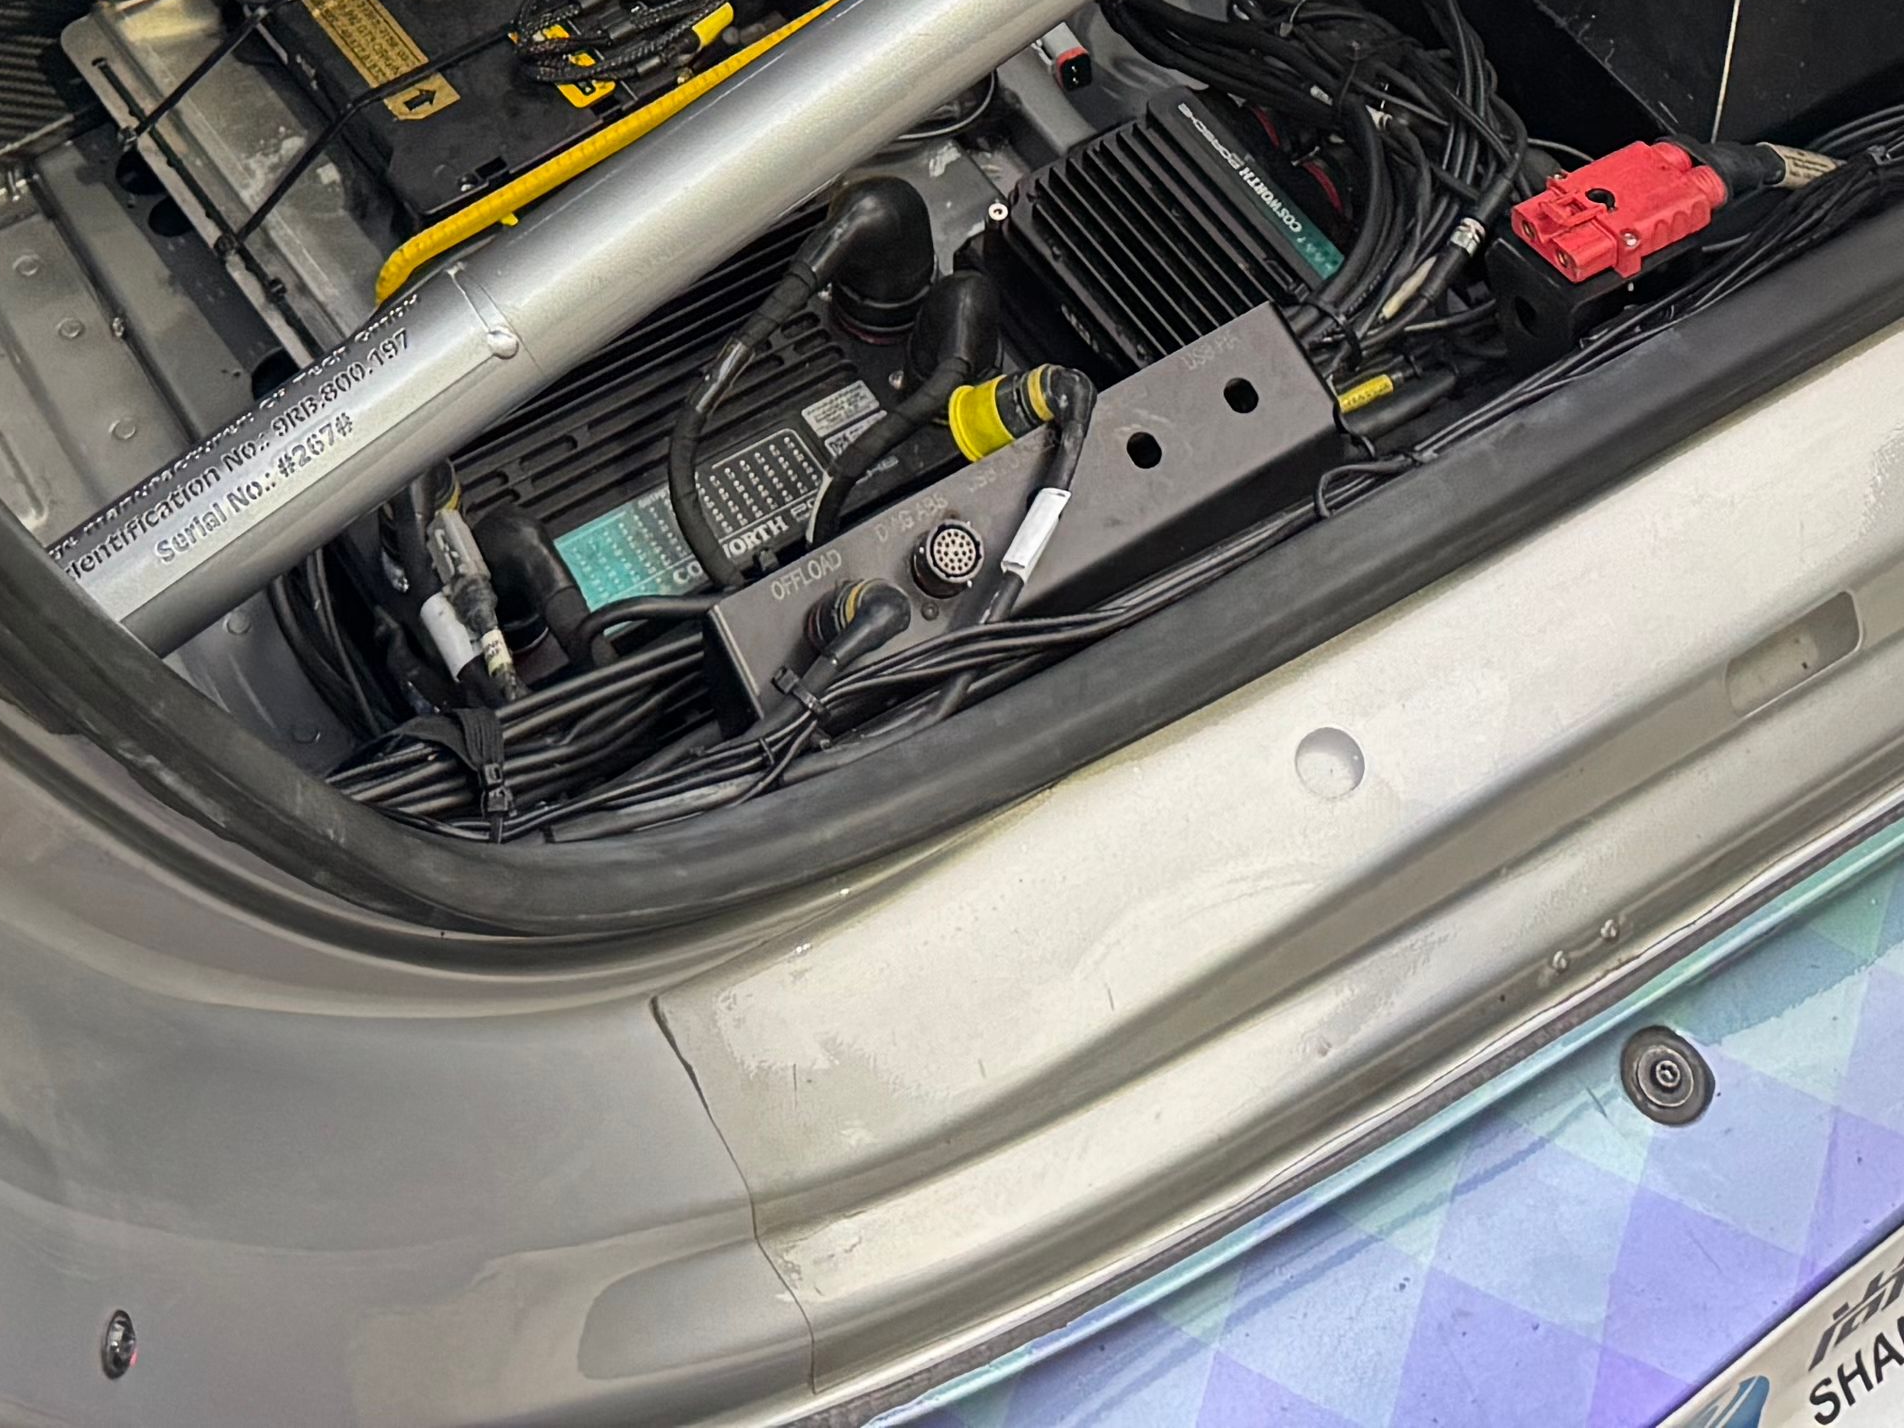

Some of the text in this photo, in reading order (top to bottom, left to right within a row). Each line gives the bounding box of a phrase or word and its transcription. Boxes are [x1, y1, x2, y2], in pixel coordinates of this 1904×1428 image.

[1239, 167, 1303, 233] COSWORTH
[64, 465, 222, 582] dentification
[271, 328, 411, 438] 9RB.800.197
[155, 502, 228, 565] Serial
[771, 548, 843, 600] OFFLOAD
